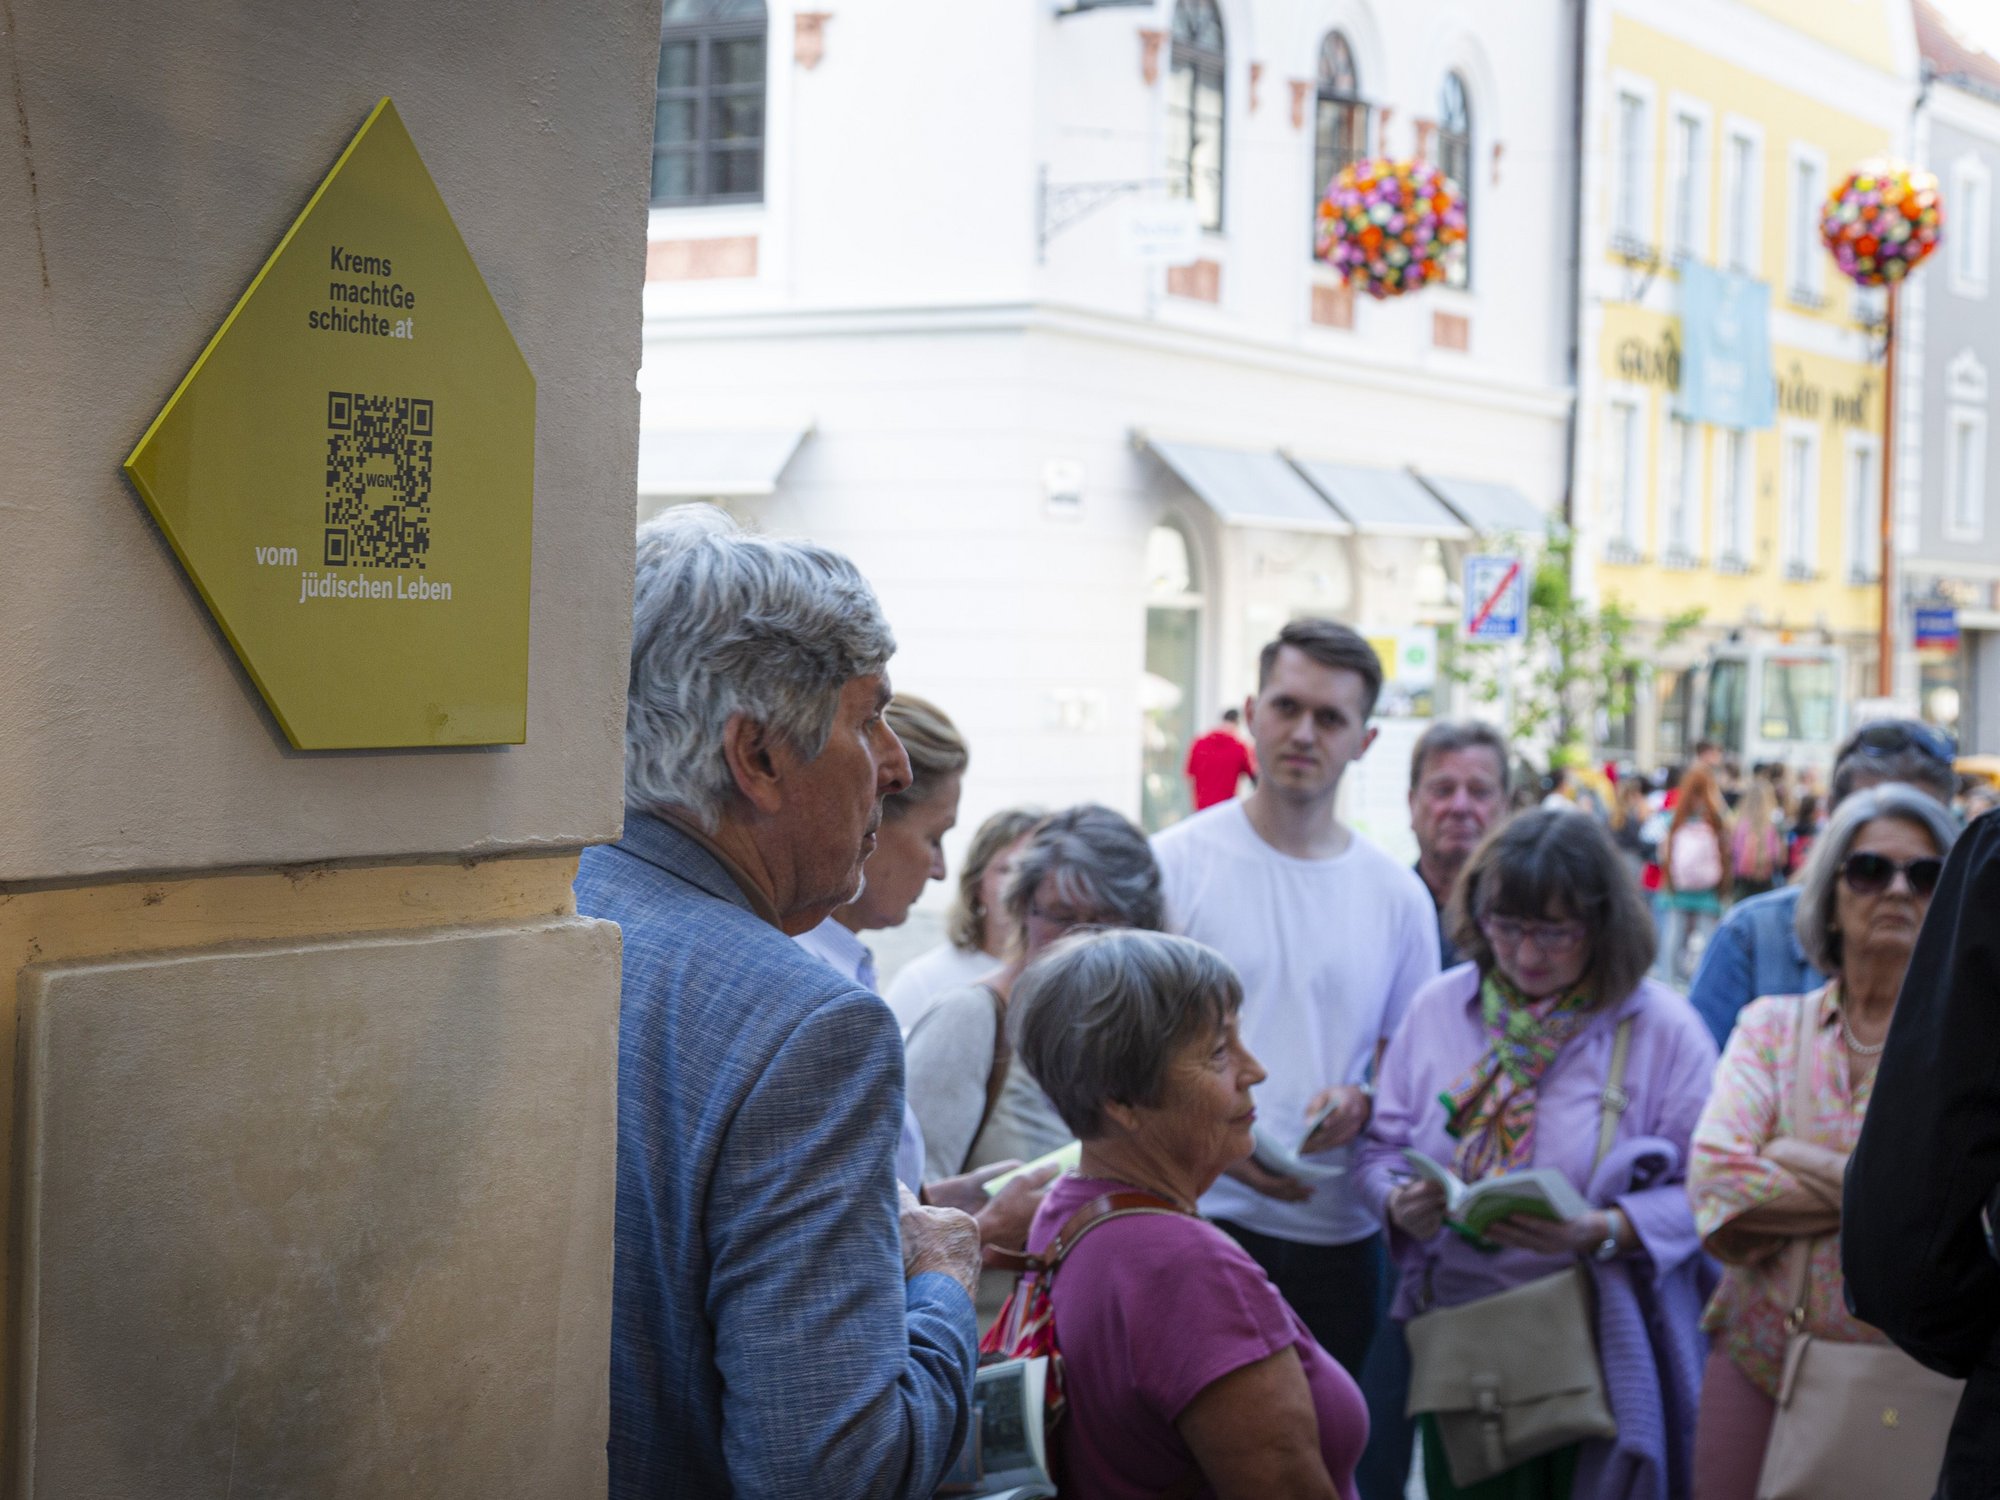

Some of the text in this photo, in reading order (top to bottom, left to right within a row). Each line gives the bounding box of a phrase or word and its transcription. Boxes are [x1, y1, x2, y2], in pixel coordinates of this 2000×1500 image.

[330, 246, 392, 277] Krems
[330, 281, 415, 309] machtGe
[308, 306, 414, 340] schichte.at
[366, 473, 393, 488] WGN
[255, 546, 298, 567] vom
[299, 571, 452, 604] jüdischen Leben
